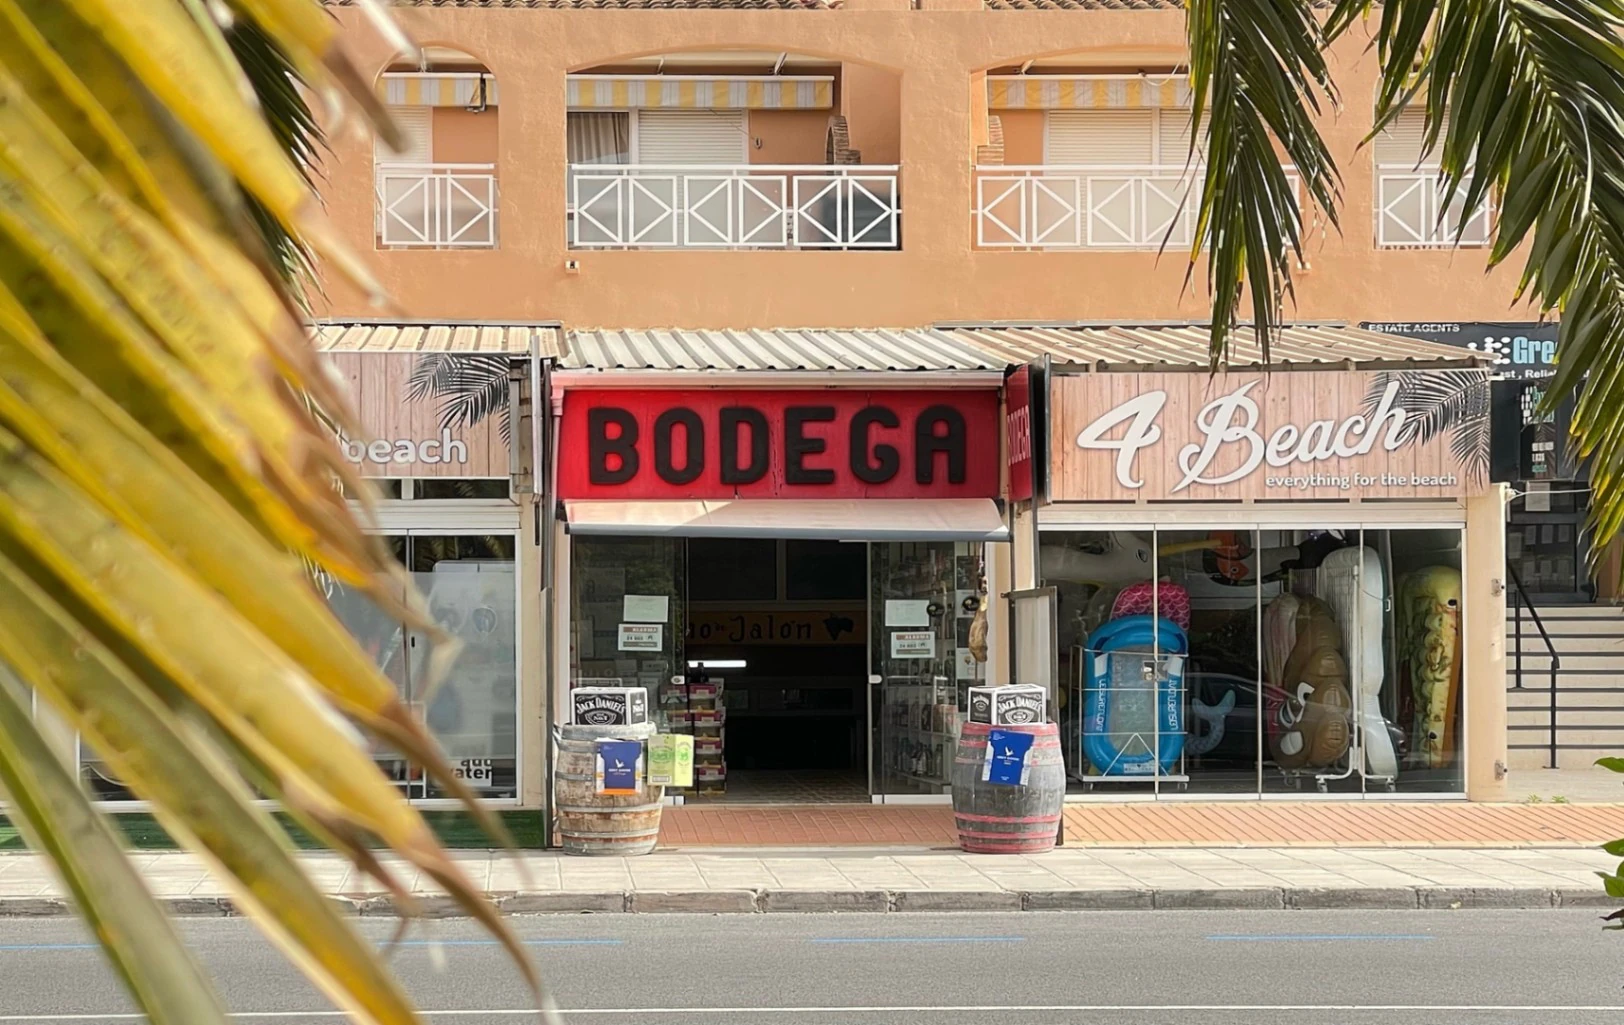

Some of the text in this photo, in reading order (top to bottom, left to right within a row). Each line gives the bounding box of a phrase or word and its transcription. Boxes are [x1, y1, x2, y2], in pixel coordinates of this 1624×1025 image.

[1368, 323, 1460, 333] ESTATE AGENTS
[1512, 336, 1558, 364] Gre
[588, 405, 967, 485] BODEGA
[1076, 379, 1409, 495] 4 Beach
[1266, 472, 1457, 490] everything for the beach
[576, 699, 596, 714] JACK
